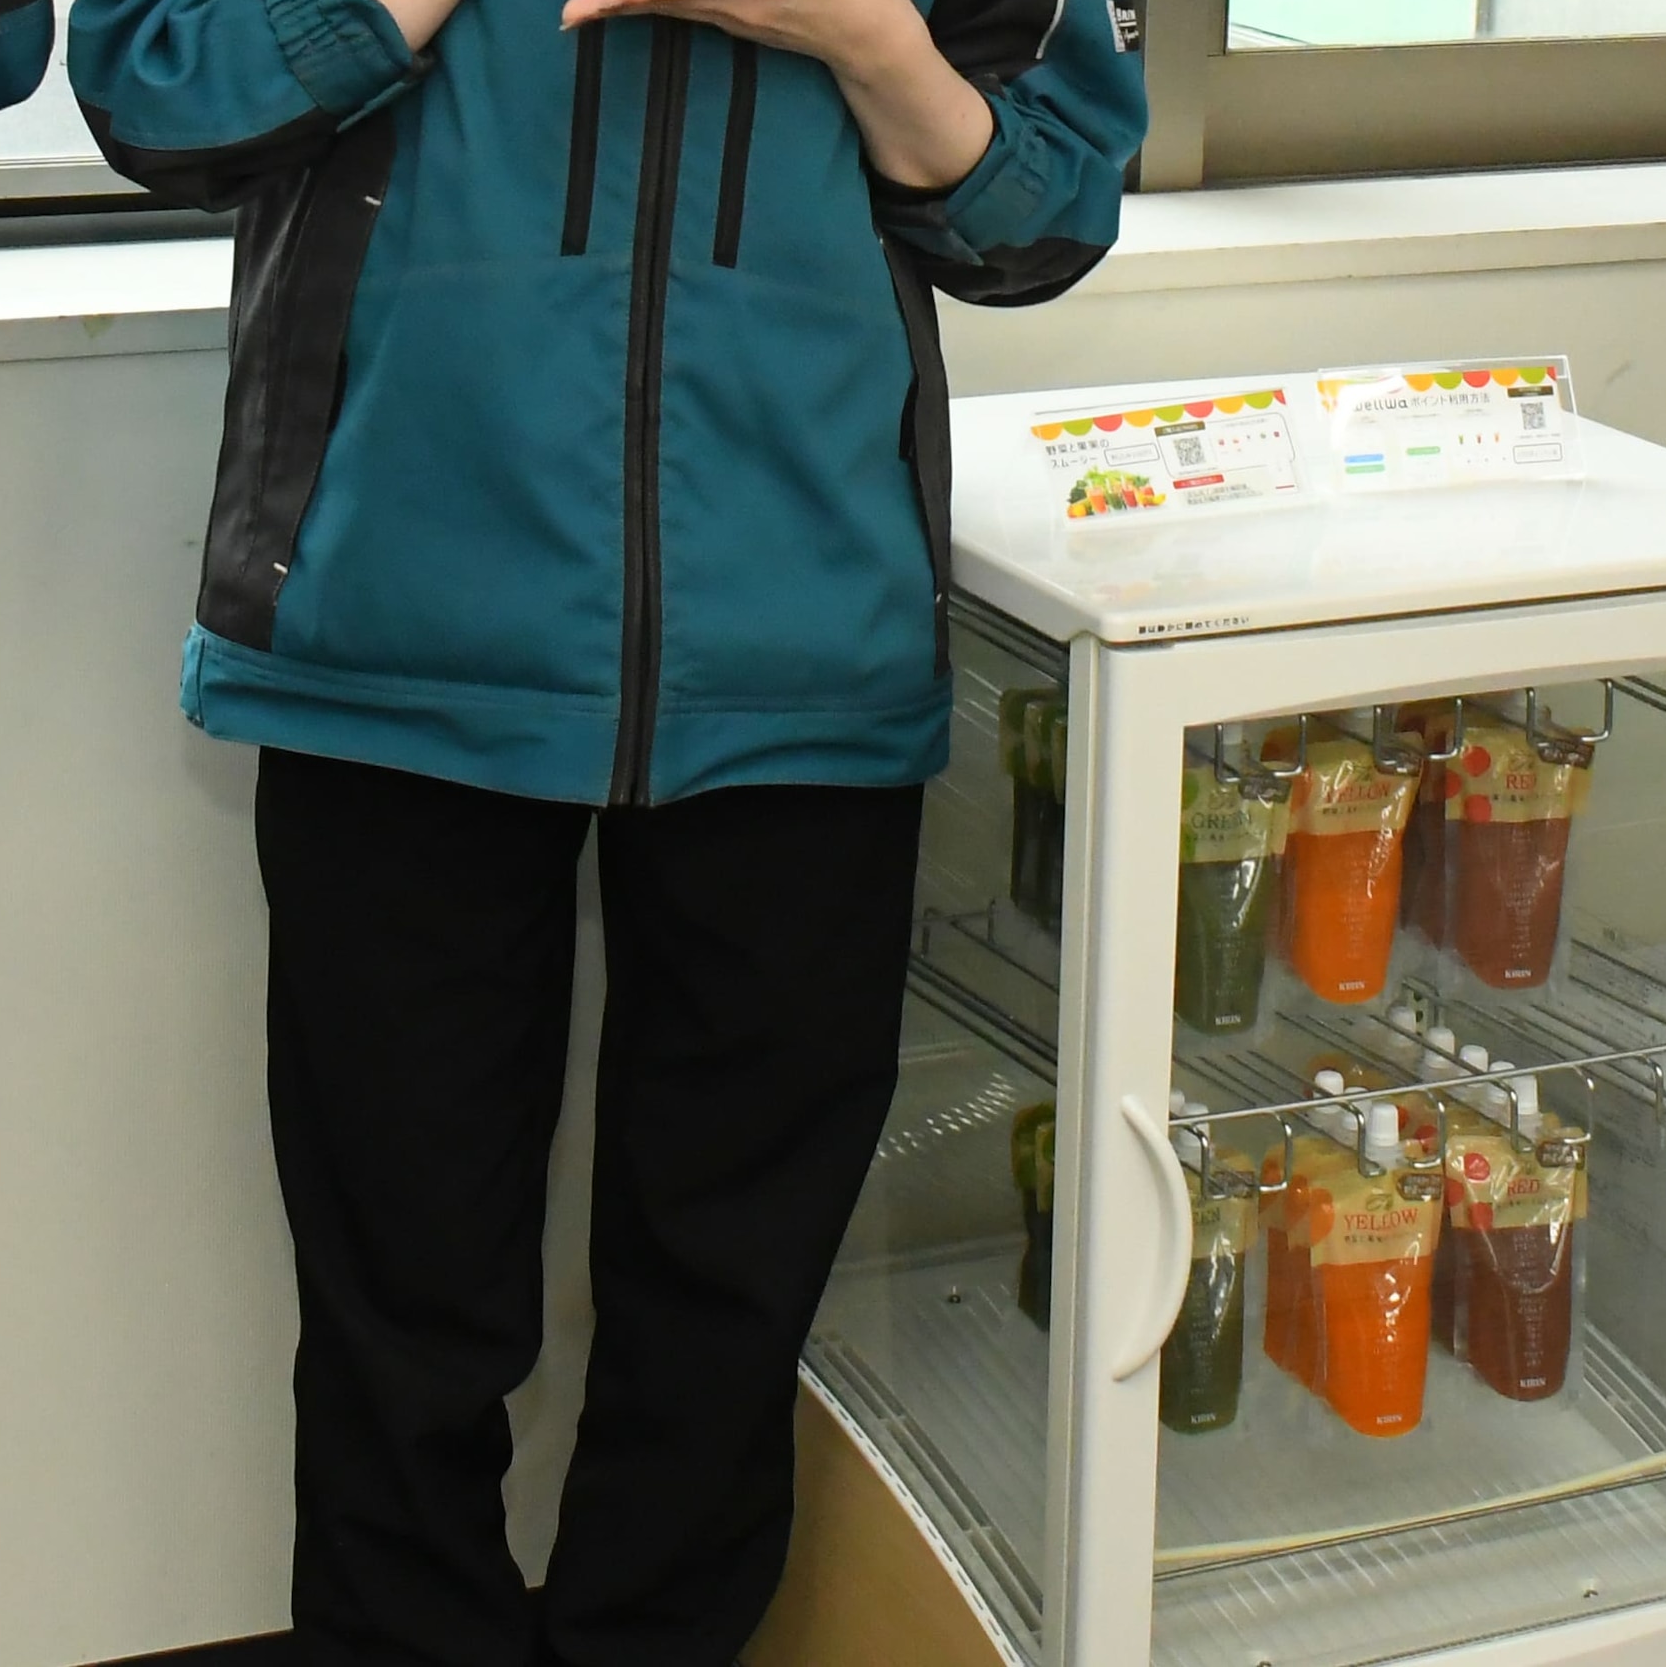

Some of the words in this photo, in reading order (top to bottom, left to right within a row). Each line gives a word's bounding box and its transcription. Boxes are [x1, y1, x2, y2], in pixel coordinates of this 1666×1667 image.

[1410, 392, 1491, 407] ポイント利用方法
[1505, 969, 1532, 979] KIRIN
[1507, 1179, 1541, 1197] RED
[1343, 1207, 1419, 1231] YELLOW
